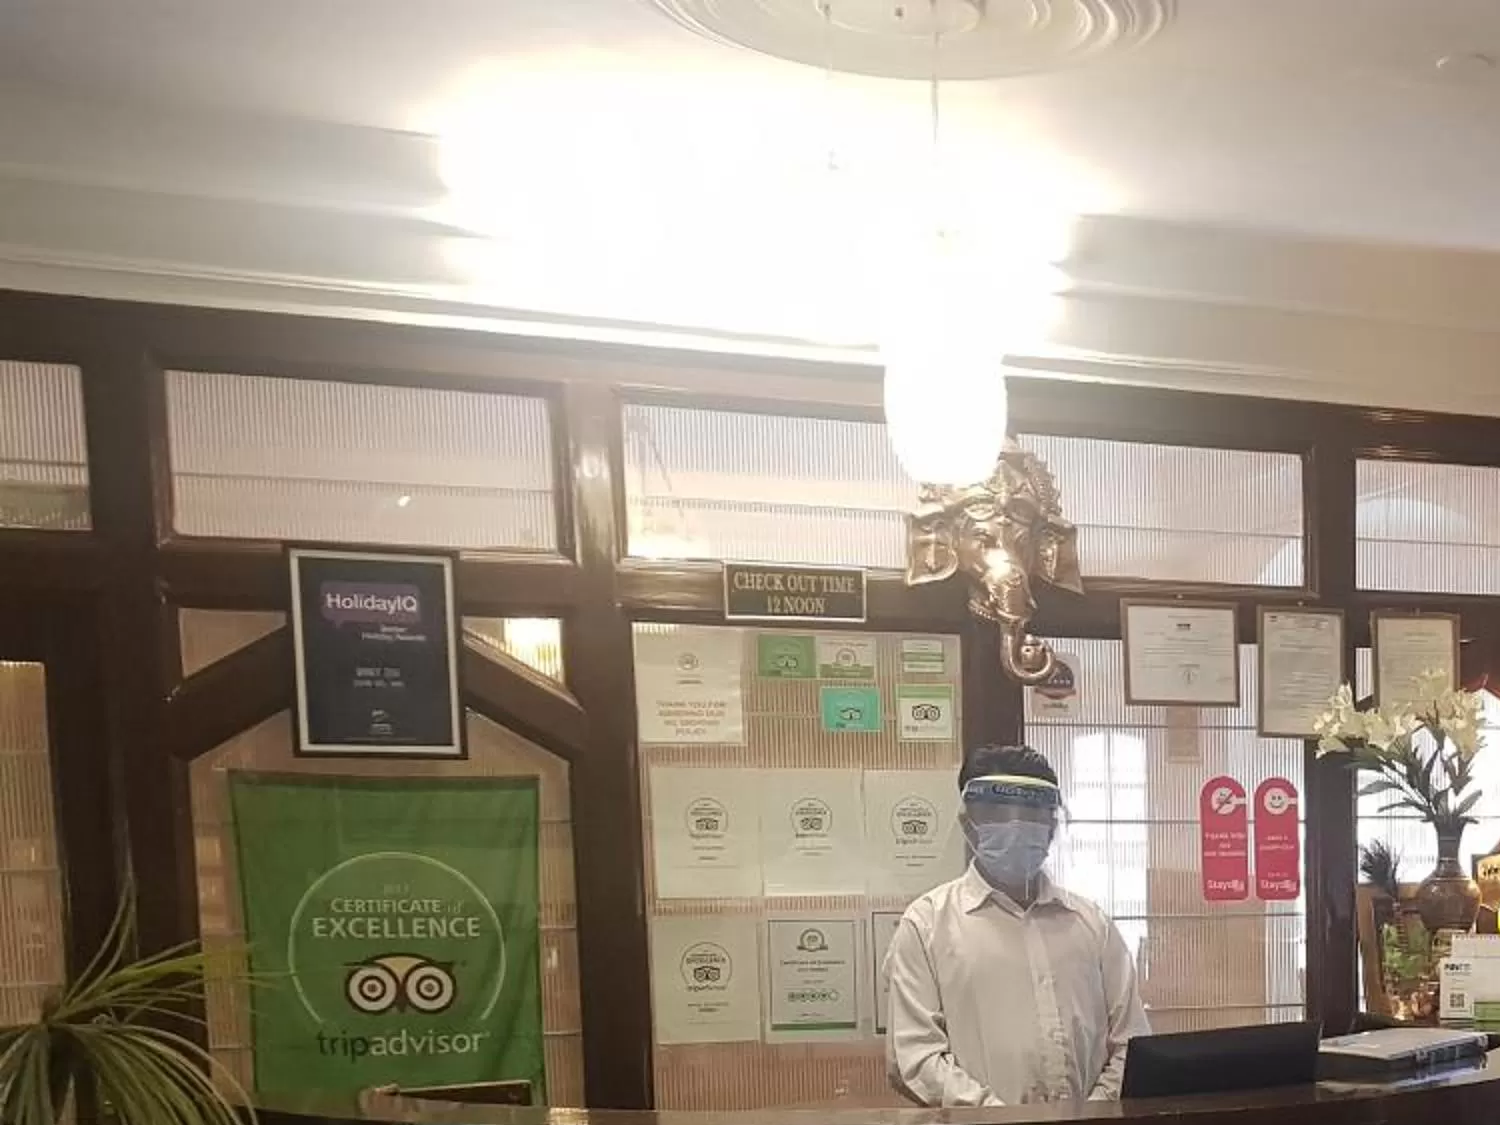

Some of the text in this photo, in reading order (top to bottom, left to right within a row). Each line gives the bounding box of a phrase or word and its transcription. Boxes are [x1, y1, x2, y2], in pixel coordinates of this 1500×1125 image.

[733, 571, 855, 593] CHECK OUT TIME
[325, 592, 418, 615] HolidayIQ
[767, 596, 826, 615] 12 NOON
[330, 899, 441, 913] CERTIFICATE
[312, 917, 481, 939] EXCELLENCE
[316, 1029, 484, 1063] tripadvisor
